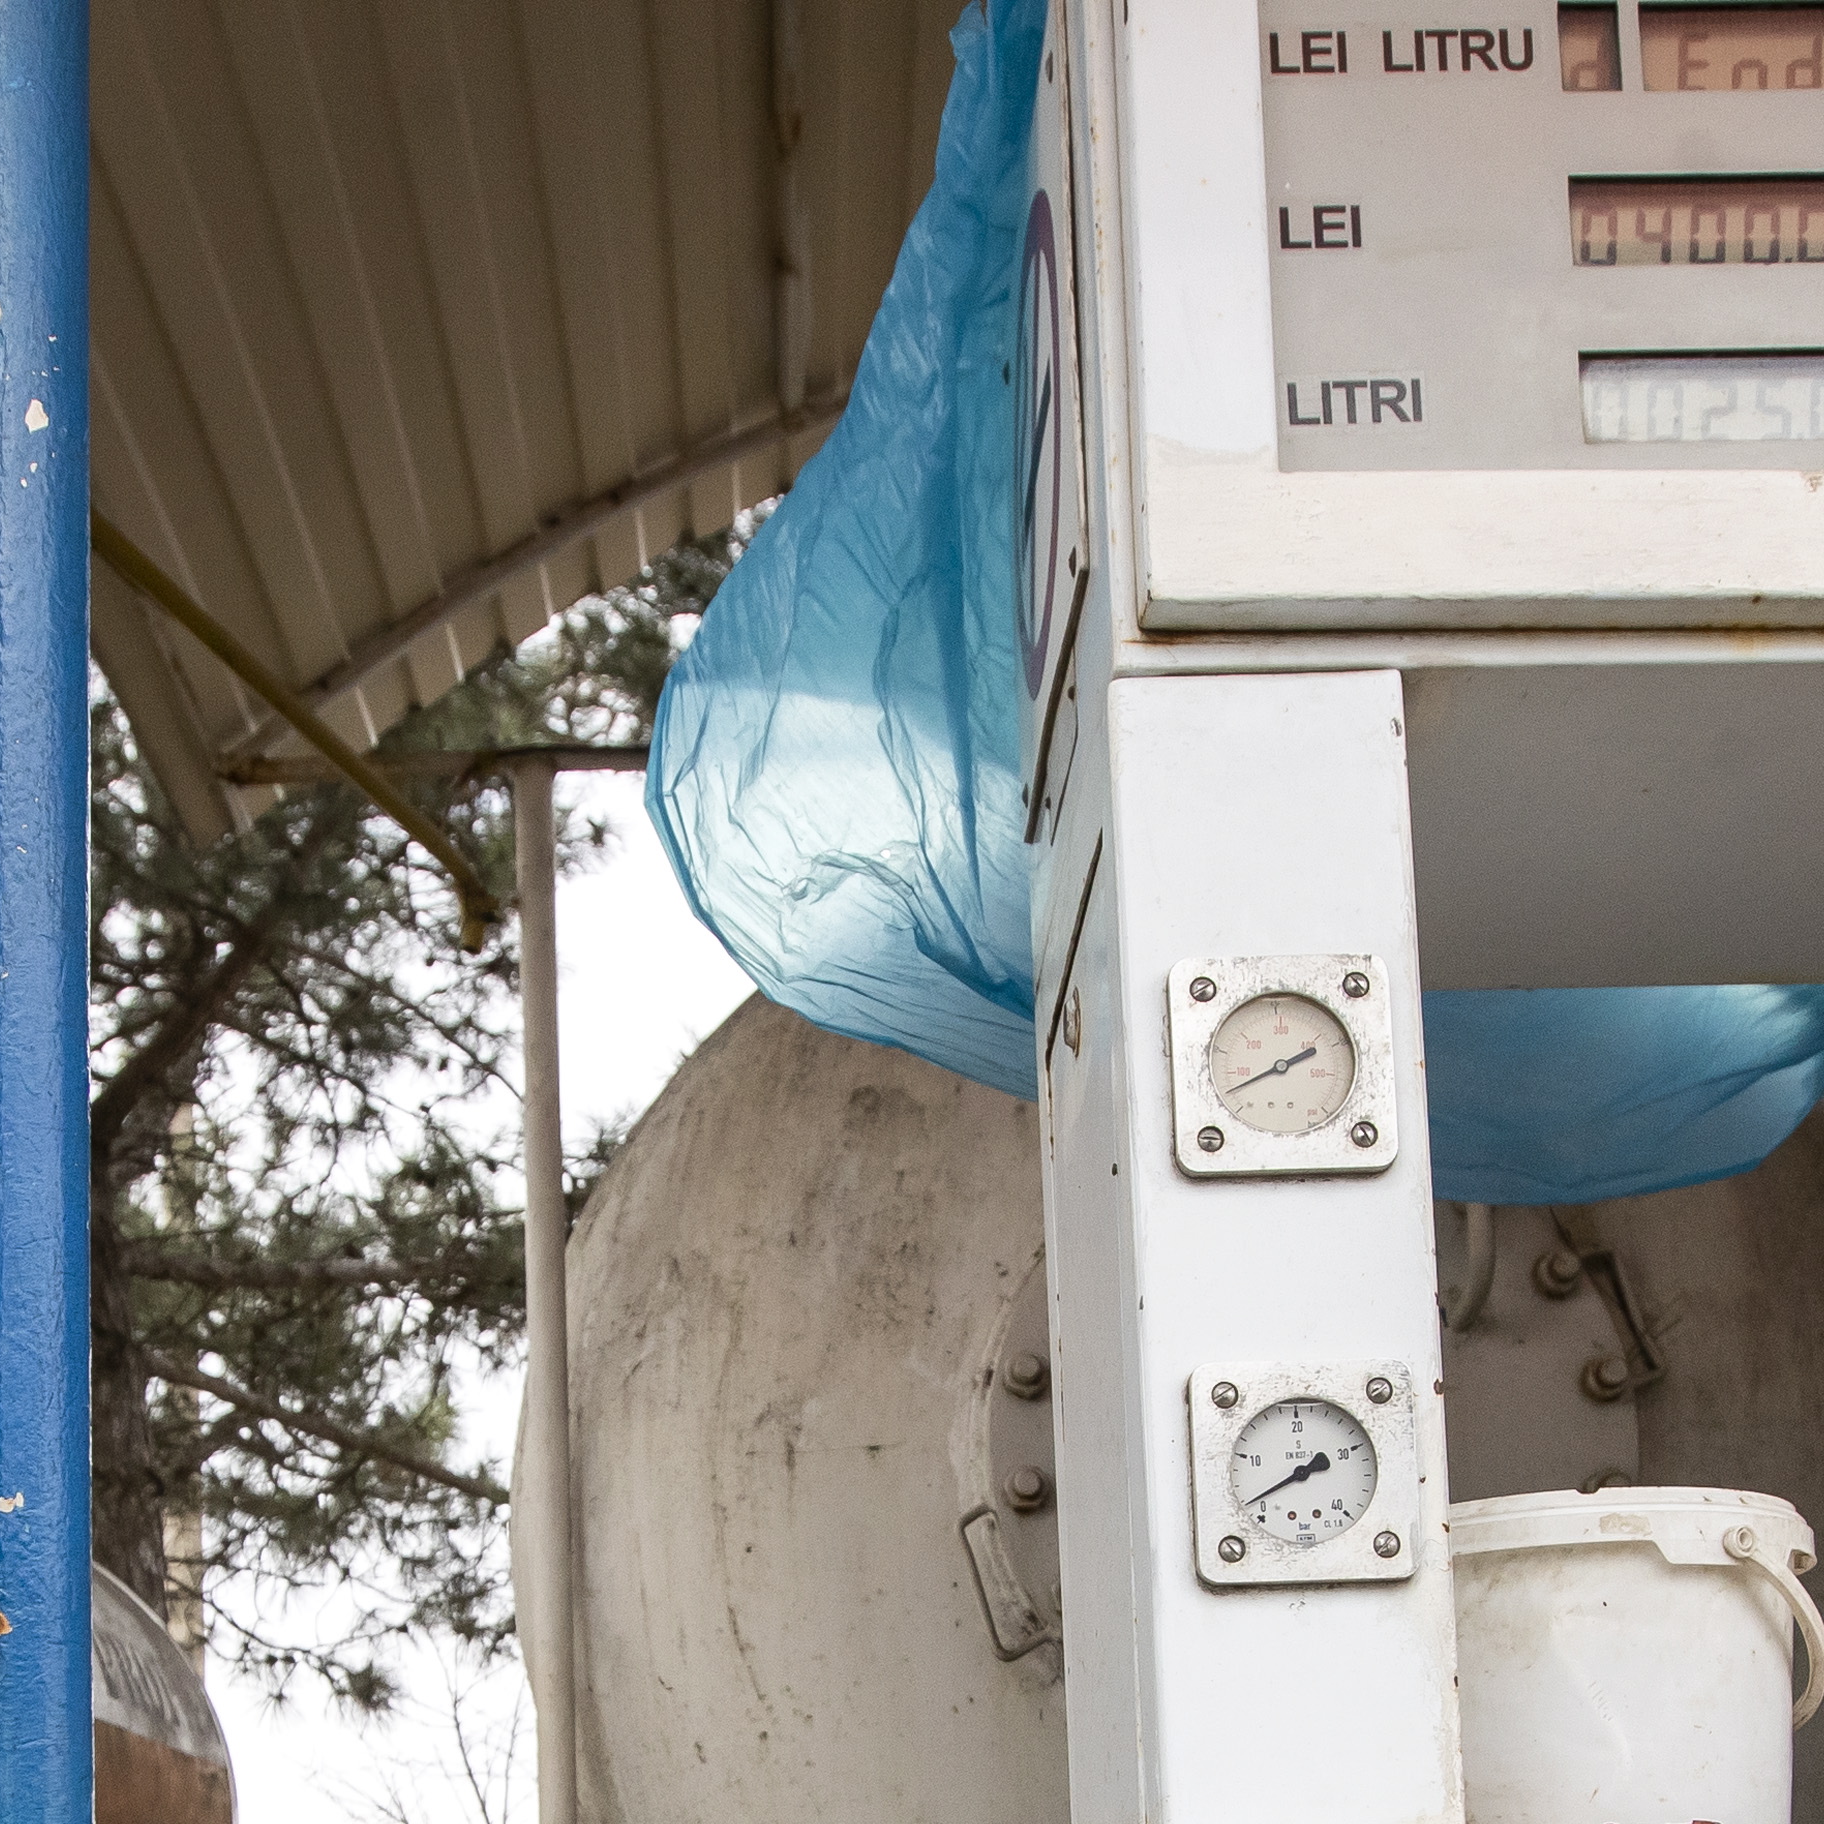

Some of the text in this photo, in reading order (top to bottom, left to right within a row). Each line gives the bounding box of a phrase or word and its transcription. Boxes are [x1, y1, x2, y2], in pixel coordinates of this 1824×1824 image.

[1270, 29, 1533, 74] LEI LITRU
[1279, 206, 1361, 249] LEI
[1287, 379, 1422, 425] LITRI
[1246, 1040, 1262, 1049] 200
[1236, 1067, 1325, 1078] 100 500
[1291, 1421, 1303, 1433] 20
[1295, 1440, 1301, 1449] S
[1250, 1448, 1349, 1467] 10 30
[1285, 1451, 1294, 1459] EN
[1260, 1499, 1343, 1512] 0 40
[1298, 1522, 1311, 1530] bar
